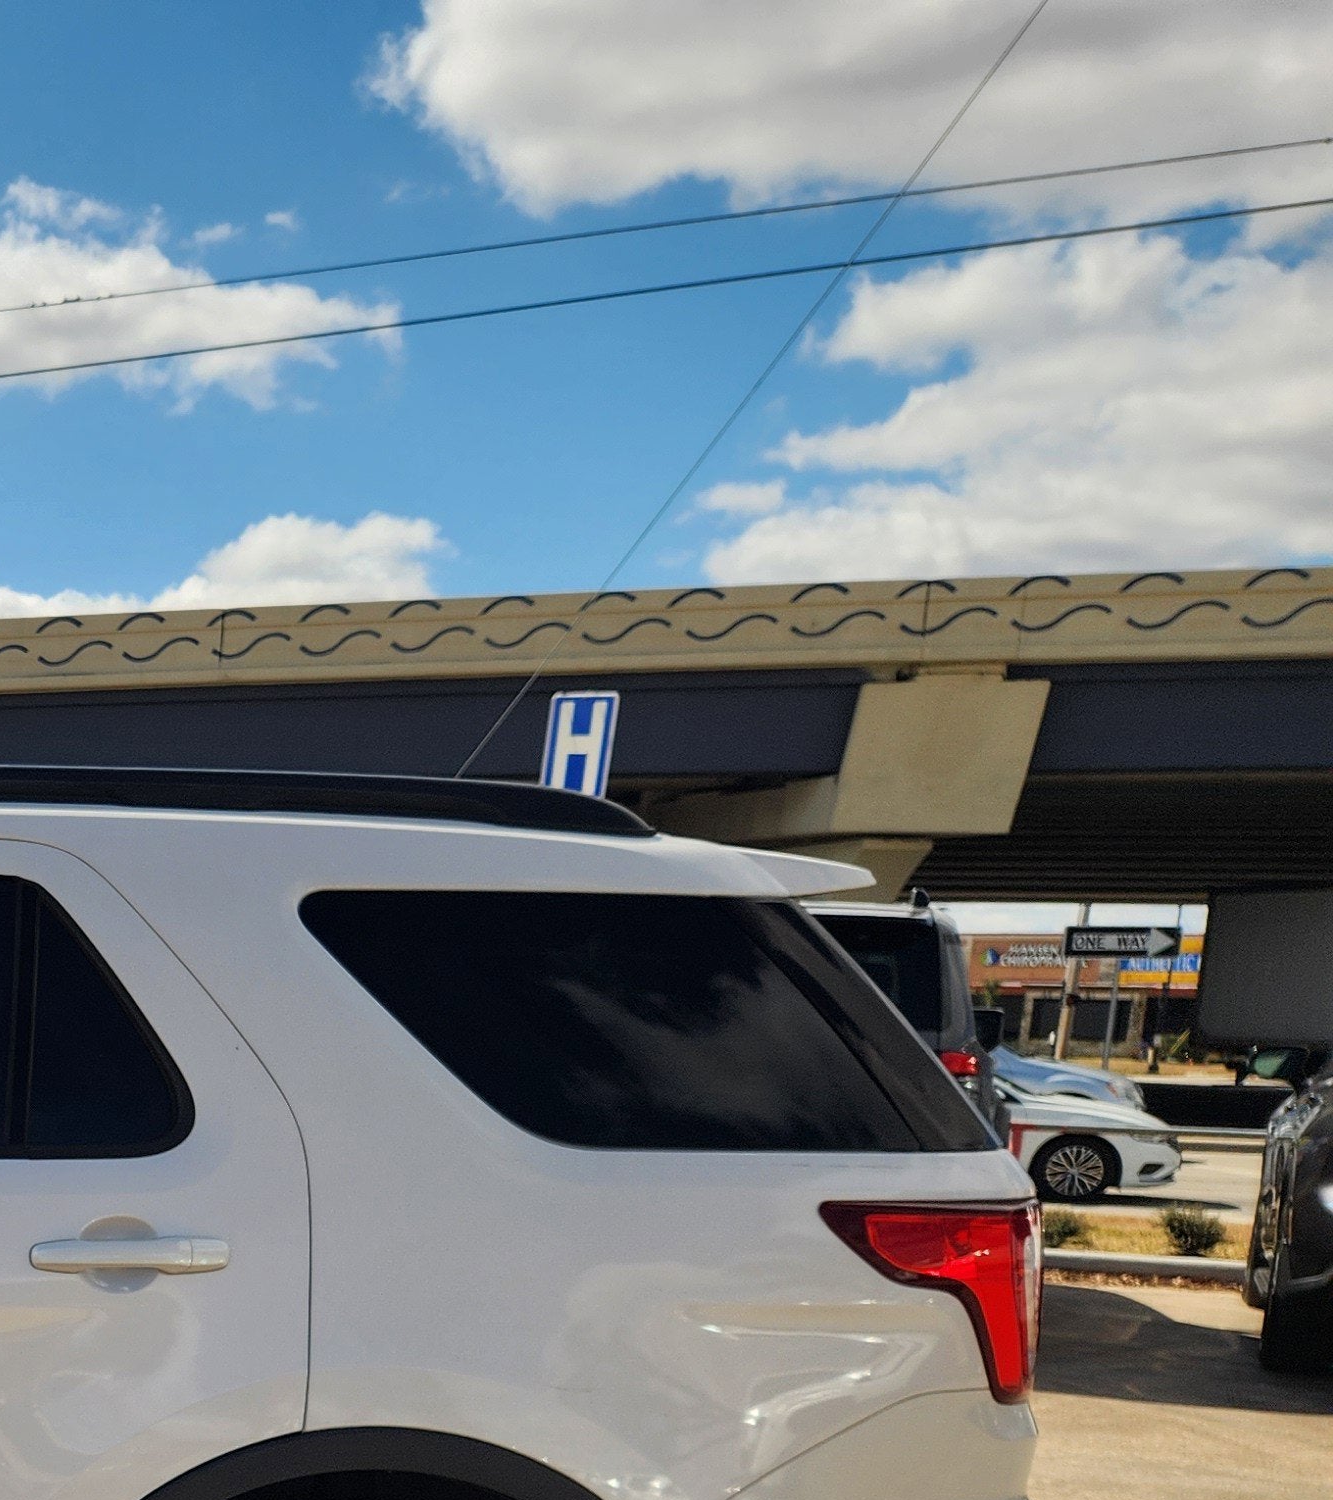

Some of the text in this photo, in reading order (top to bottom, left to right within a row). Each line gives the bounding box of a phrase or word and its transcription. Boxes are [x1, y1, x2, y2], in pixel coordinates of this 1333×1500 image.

[550, 701, 608, 796] H
[1074, 936, 1147, 950] ONE WAY
